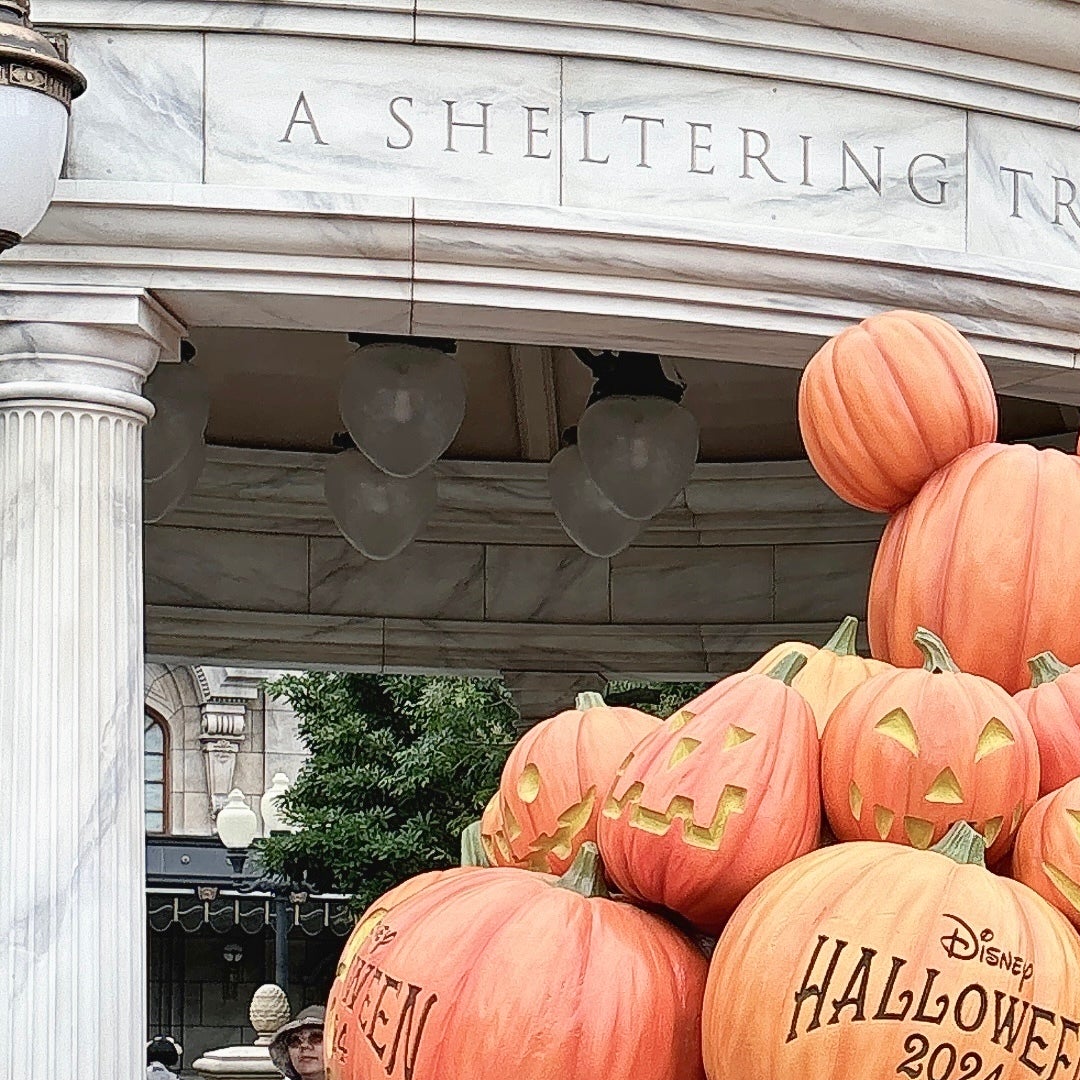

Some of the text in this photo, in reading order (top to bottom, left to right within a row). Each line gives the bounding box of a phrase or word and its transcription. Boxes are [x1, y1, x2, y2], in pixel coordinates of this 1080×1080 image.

[279, 90, 330, 146] A
[386, 96, 949, 206] SHELTERING
[940, 913, 1034, 992] Disney
